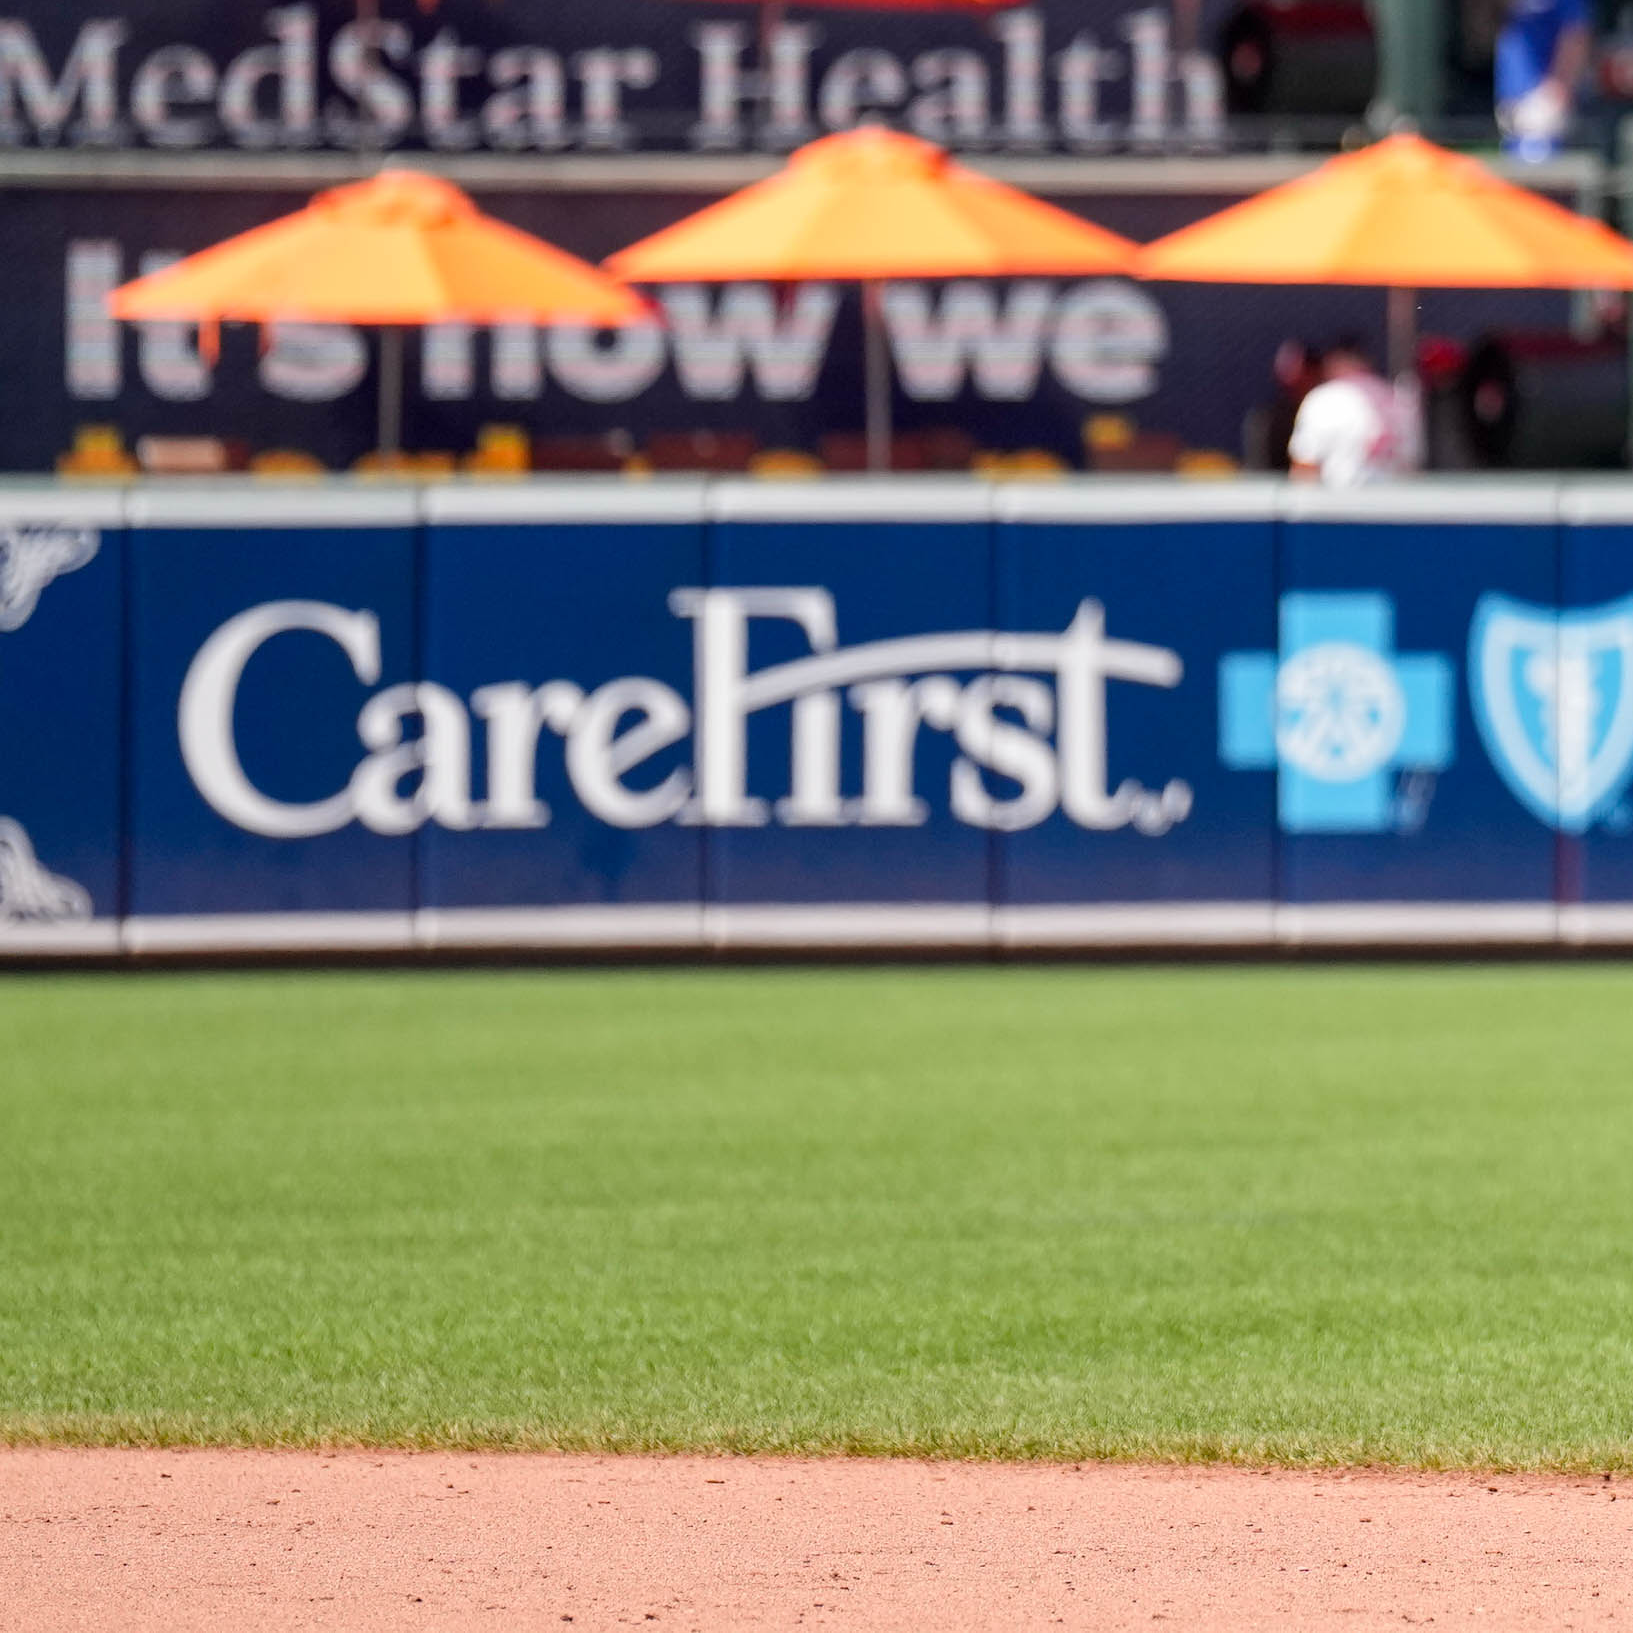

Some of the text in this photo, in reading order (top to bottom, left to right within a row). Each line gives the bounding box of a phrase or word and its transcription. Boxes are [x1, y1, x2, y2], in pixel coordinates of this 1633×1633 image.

[0, 4, 1227, 150] MedStar Health
[65, 240, 368, 401] Its
[881, 278, 1168, 402] we
[178, 586, 1184, 838] CareFirst
